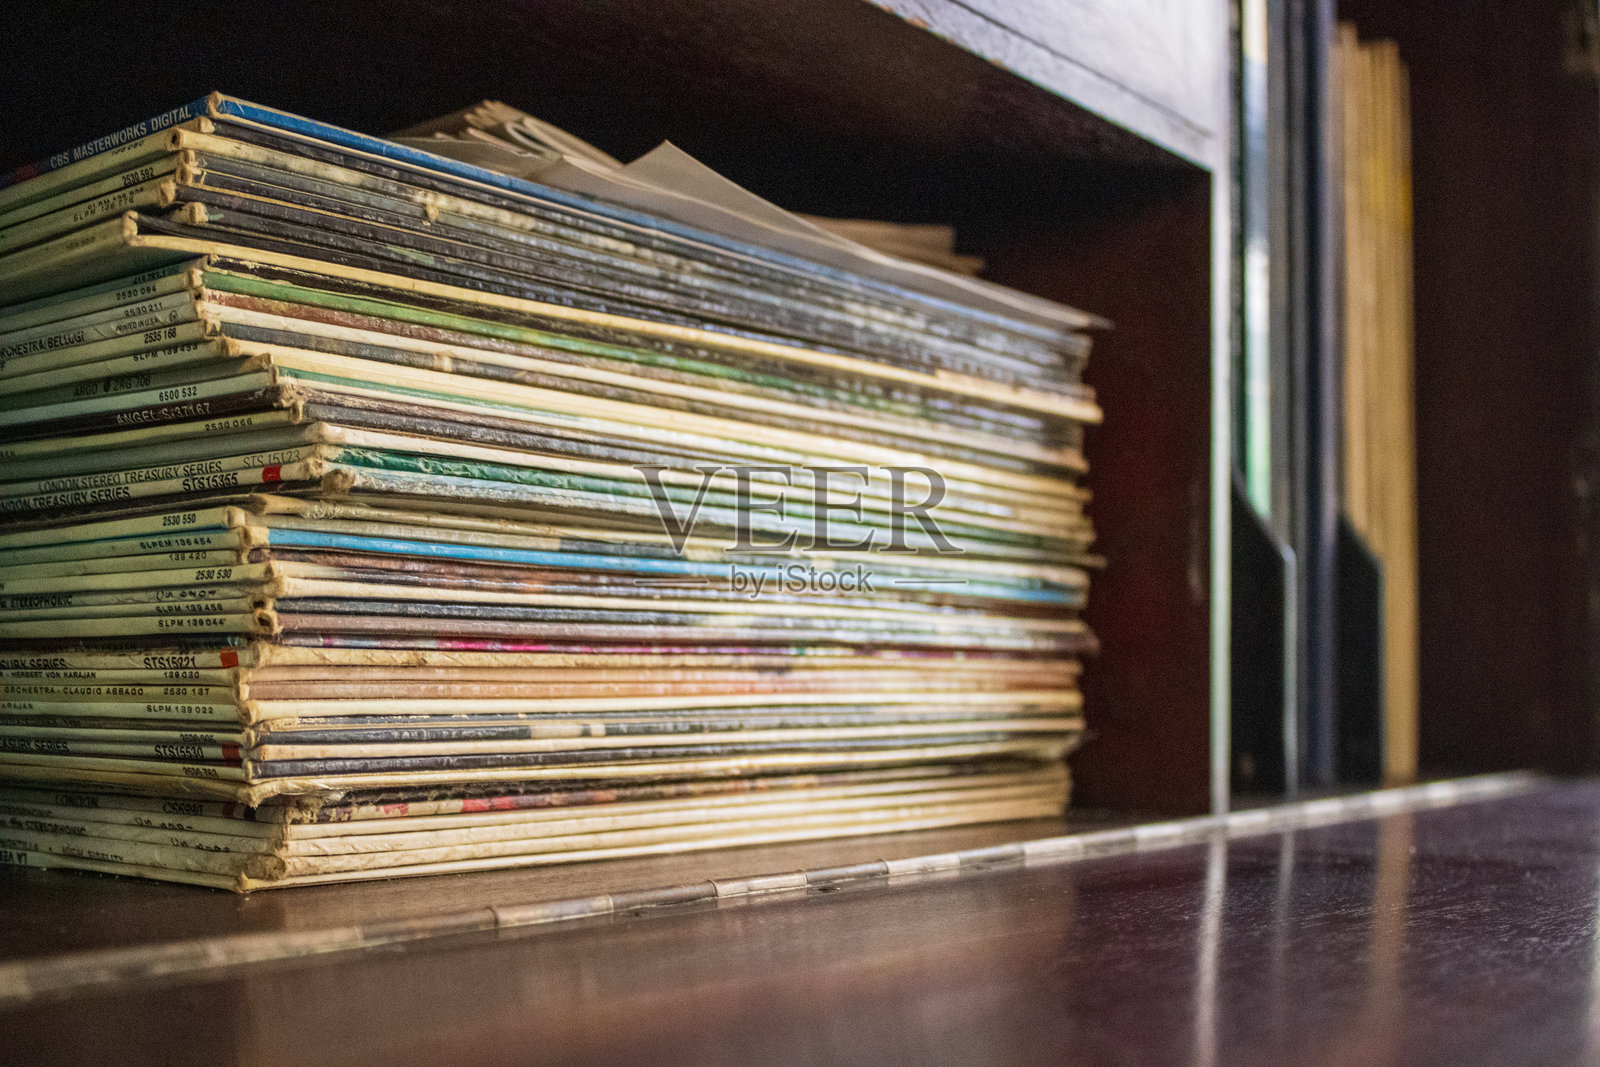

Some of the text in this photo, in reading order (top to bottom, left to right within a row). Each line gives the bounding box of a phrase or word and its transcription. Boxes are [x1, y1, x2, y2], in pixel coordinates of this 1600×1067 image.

[50, 152, 70, 169] CBS
[73, 121, 147, 160] MASTERWORKS
[151, 105, 192, 132] DIGITAL
[121, 167, 155, 186] 2530 592
[116, 289, 138, 301] 2530
[124, 302, 163, 318] 2530 211
[143, 331, 162, 344] 2535
[73, 384, 98, 397] ARGO
[159, 386, 198, 402] 6500 532
[115, 409, 159, 425] ANGEL
[205, 417, 253, 431] 2530 066
[38, 478, 79, 494] LONDON
[81, 472, 121, 489] STEREO
[124, 466, 181, 484] TREASURY
[183, 461, 223, 476] SERIES
[33, 491, 88, 509] TREASURY
[90, 486, 131, 502] SERIES
[182, 472, 239, 492] STS15355
[162, 513, 197, 526] 2530 550
[139, 538, 173, 549] SLPEM
[188, 550, 207, 560] 420
[195, 568, 232, 580] 2530 530
[158, 619, 184, 628] SLPM
[29, 657, 68, 669] SERIES
[11, 671, 43, 679] HERBERT
[45, 671, 61, 679] VON
[63, 671, 96, 679] KARAJAN
[3, 686, 56, 694] ORCHESTRA
[63, 687, 102, 695] CLAUDIO
[105, 687, 144, 696] ABBADO
[163, 687, 187, 696] 2530
[146, 704, 214, 715] SLPM 139 022
[34, 740, 70, 753] SERIES
[155, 744, 204, 760] STS15530
